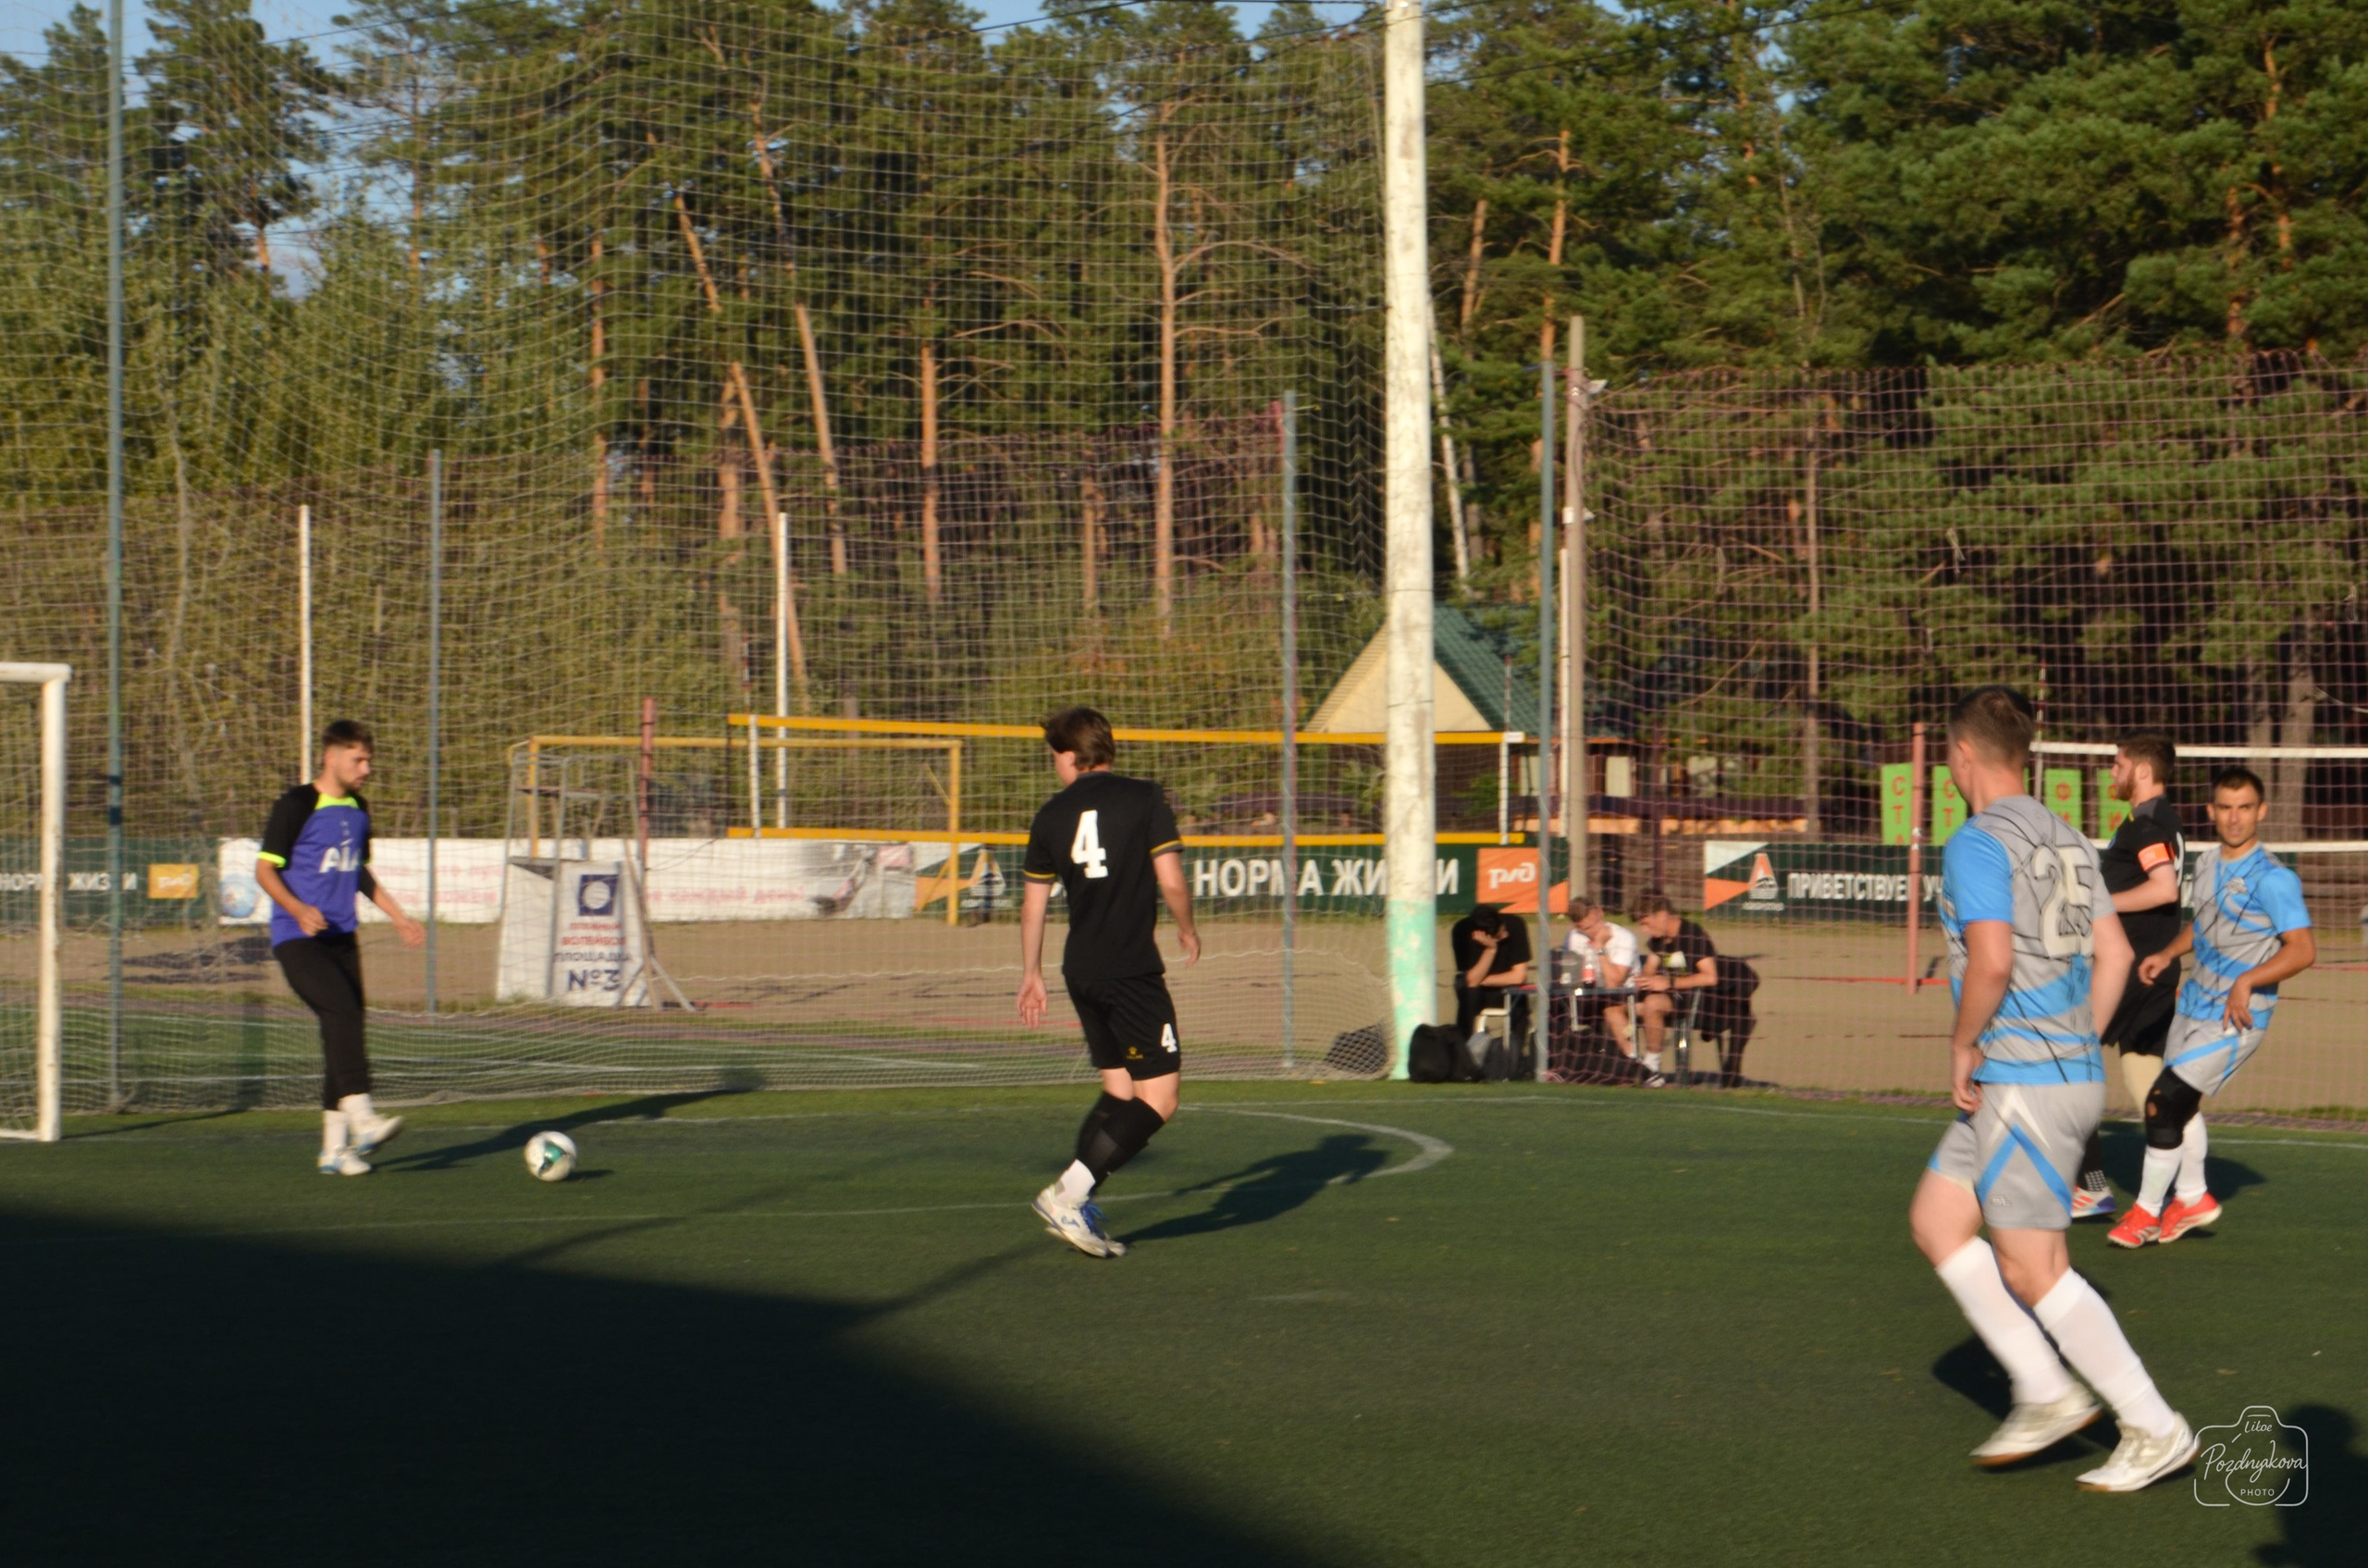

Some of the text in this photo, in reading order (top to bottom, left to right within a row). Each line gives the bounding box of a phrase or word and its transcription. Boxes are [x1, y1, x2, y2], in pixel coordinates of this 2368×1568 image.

[1070, 809, 1109, 879] 4
[68, 871, 138, 891] ЖИЗИ
[1193, 858, 1459, 897] НОРМА ЖИИ
[2031, 842, 2093, 958] 25
[1161, 1022, 1178, 1053] 4
